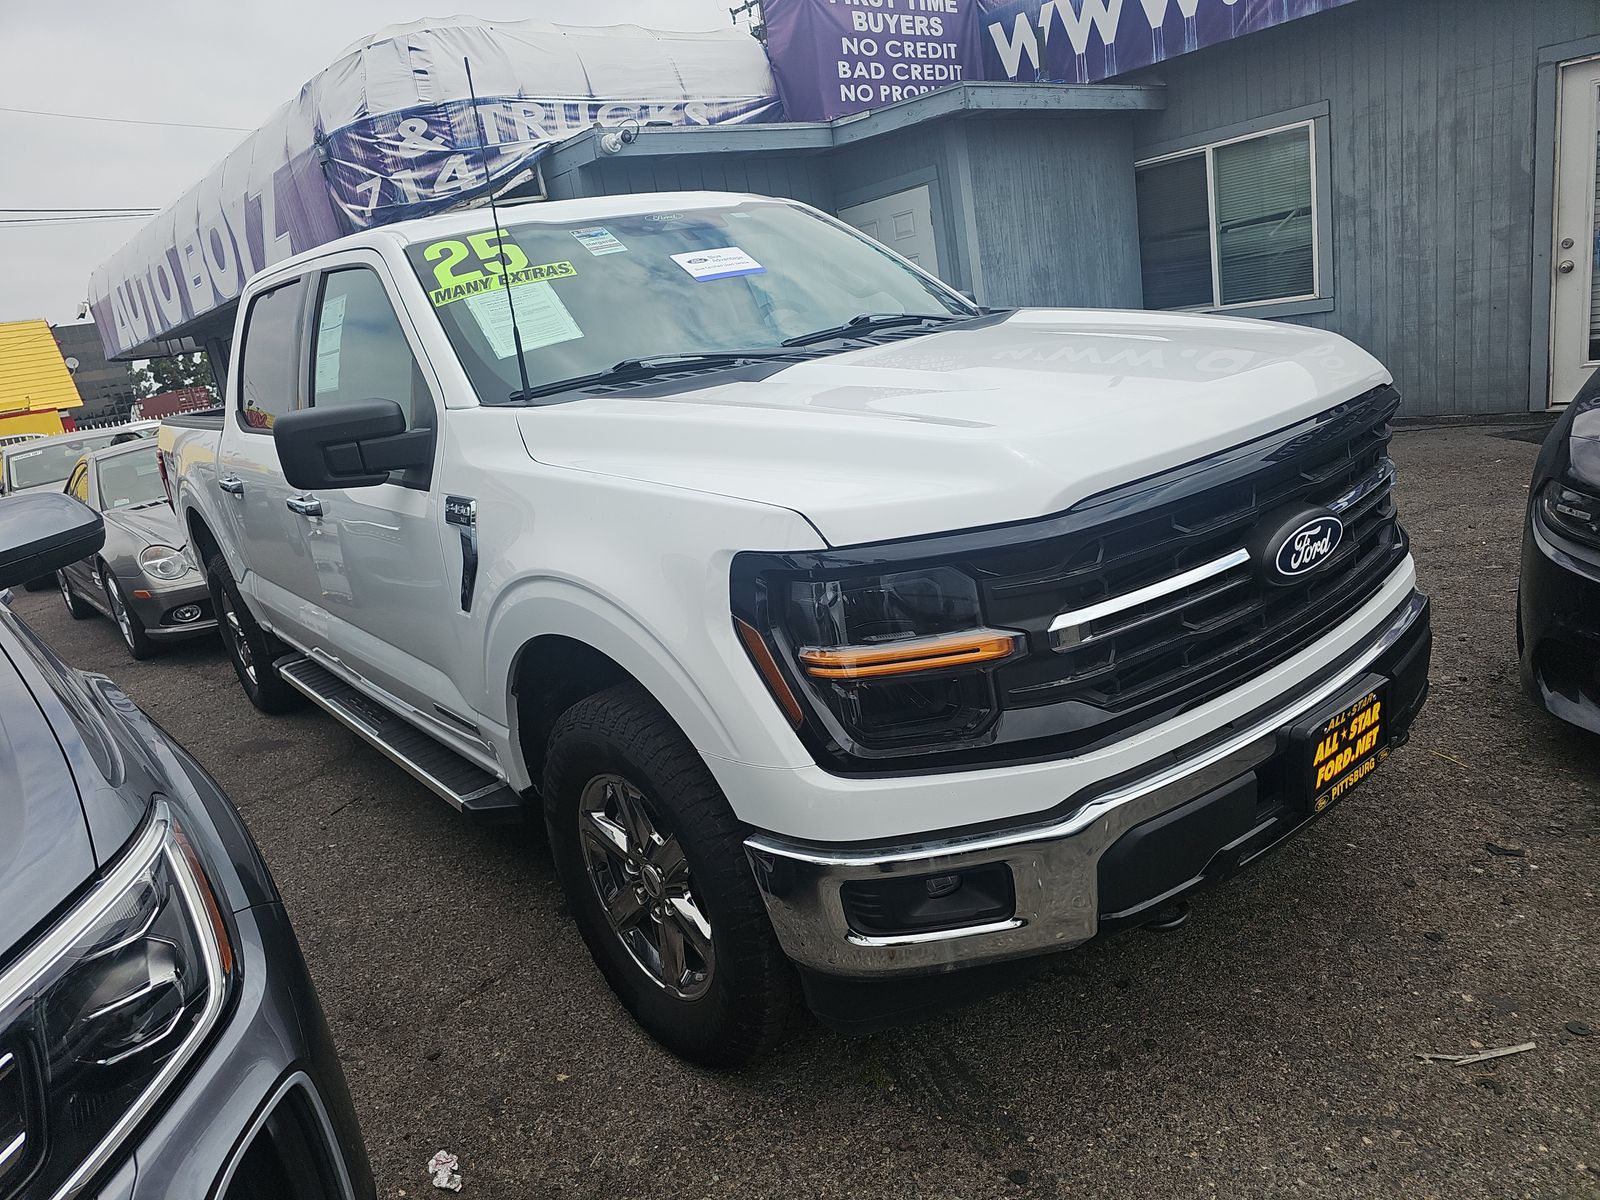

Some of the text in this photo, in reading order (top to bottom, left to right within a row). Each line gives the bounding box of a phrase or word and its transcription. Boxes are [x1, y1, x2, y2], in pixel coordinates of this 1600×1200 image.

[851, 10, 944, 37] BUYERS
[841, 37, 957, 60] NO CREDIT
[837, 60, 962, 81] BAD CREDIT
[840, 84, 874, 102] NO
[398, 118, 452, 158] &
[356, 153, 479, 217] 714
[110, 250, 183, 351] AUTO
[174, 172, 294, 317] BOYZ
[423, 229, 530, 287] 25
[434, 262, 574, 305] MANY EXTRAS
[1291, 525, 1332, 570] Ford
[1328, 692, 1374, 732] ALL STAR
[1313, 701, 1381, 767] ALL STAR
[1315, 725, 1379, 790] FORD.NET
[1331, 758, 1375, 801] PITTSBURG
